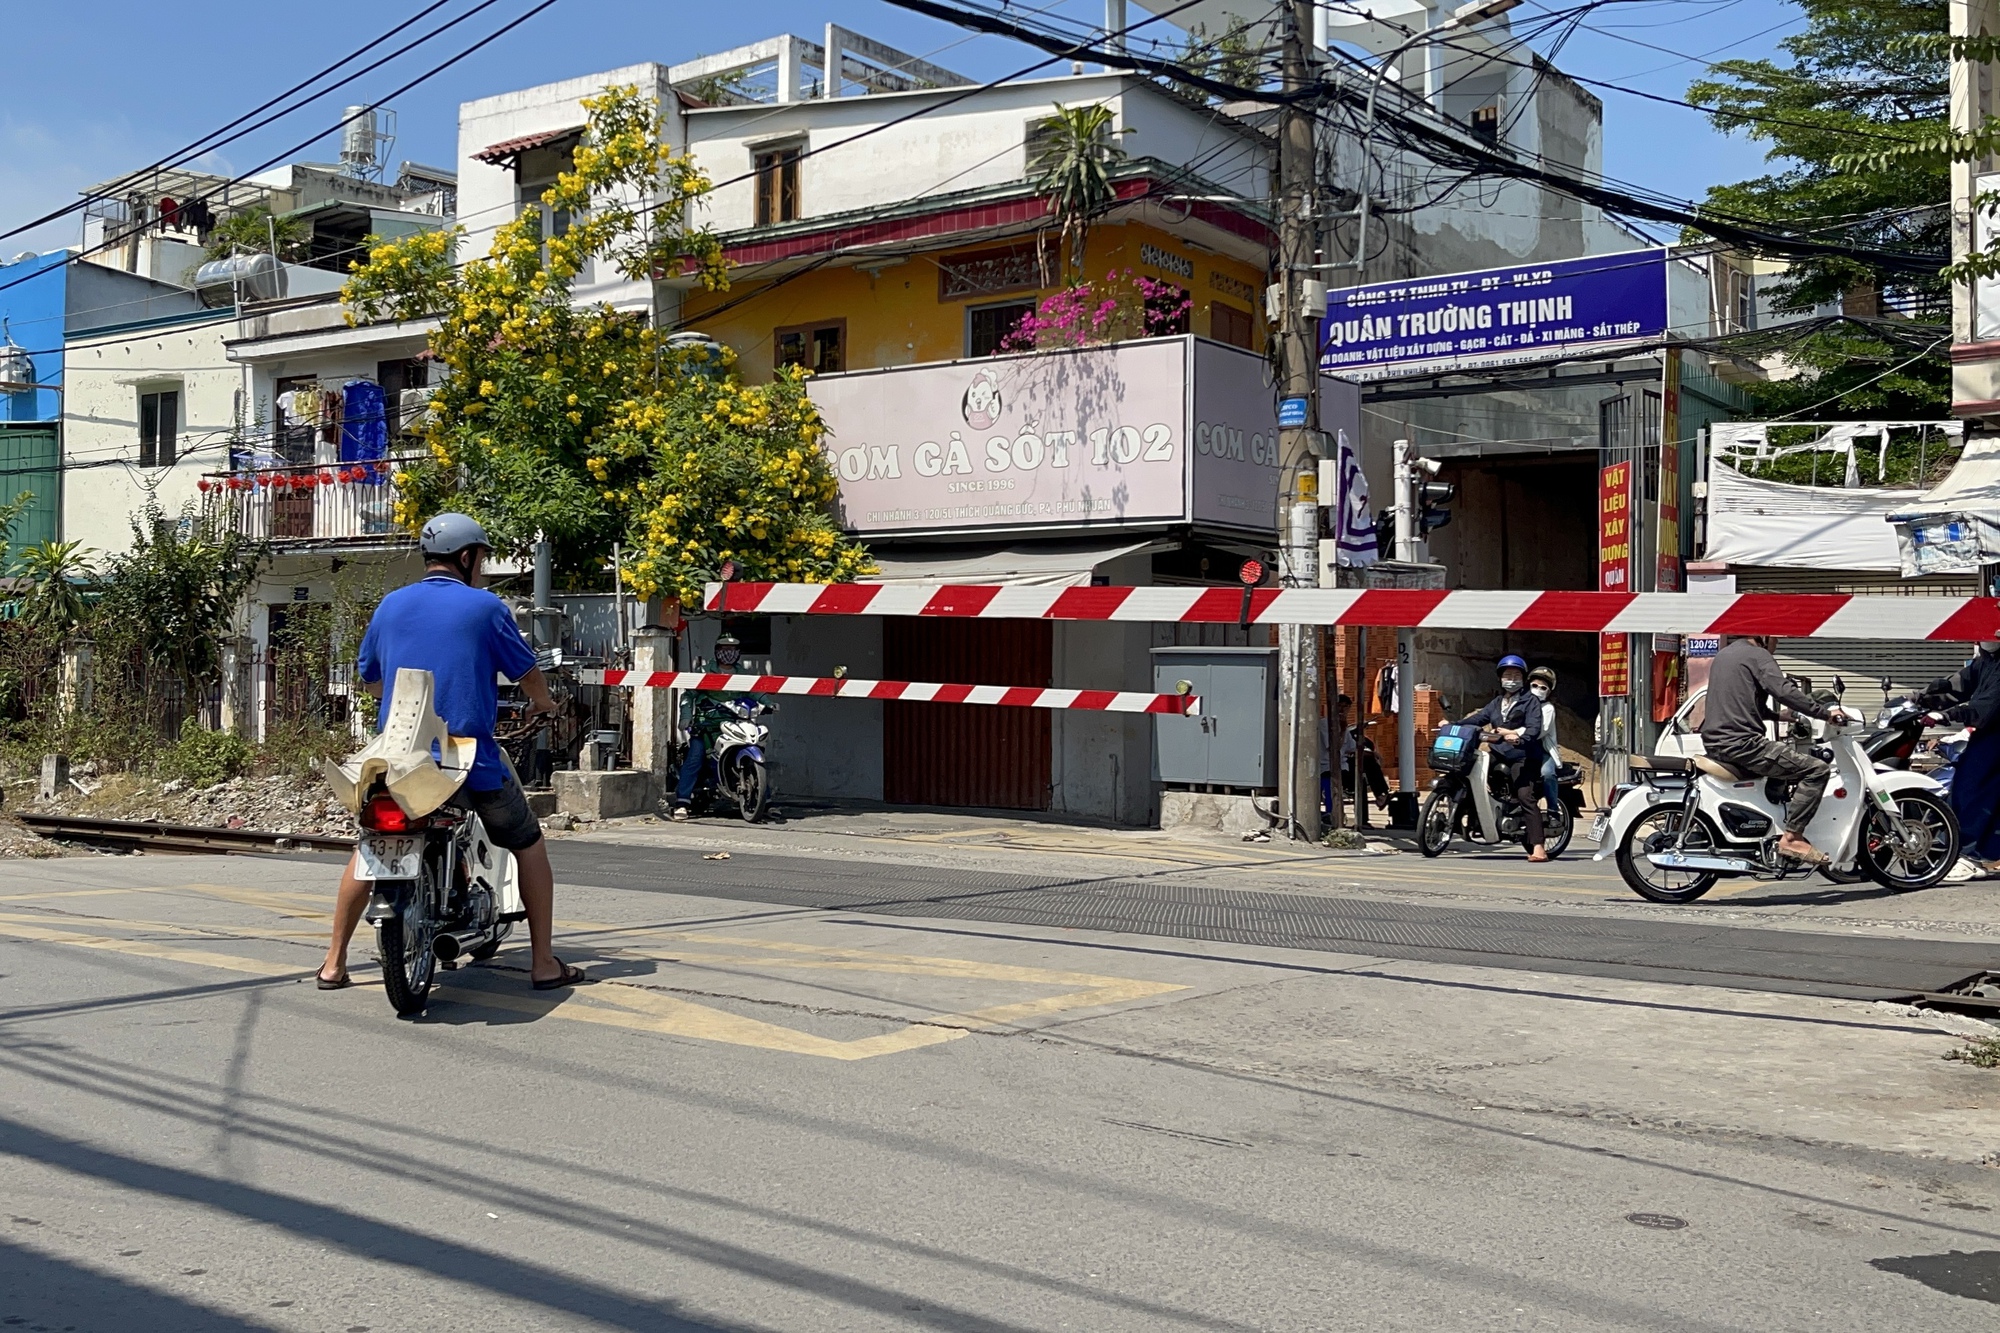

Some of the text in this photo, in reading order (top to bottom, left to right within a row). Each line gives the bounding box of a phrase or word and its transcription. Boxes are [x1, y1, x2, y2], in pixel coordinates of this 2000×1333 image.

[1346, 289, 1387, 308] CÔNG
[1513, 270, 1553, 288] VLXD
[1330, 295, 1572, 347] QUÂN TRƯỜNG THỊNH
[1331, 350, 1366, 364] DOANH:
[1366, 345, 1383, 362] VẬT
[1384, 343, 1406, 360] LIỆU
[1406, 341, 1426, 355] XÂY
[1426, 340, 1453, 355] DỰNG
[1460, 337, 1485, 351] GẠCH
[1493, 332, 1513, 347] CÁT
[1520, 329, 1534, 344] ĐÁ
[1542, 331, 1552, 342] XI
[1554, 326, 1585, 341] MĂNG
[1592, 321, 1613, 337] SẮT
[1614, 320, 1641, 335] THÉP
[913, 431, 974, 478] GÀ
[984, 419, 1077, 473] SỐT
[1089, 423, 1175, 467] 102
[1195, 420, 1246, 463] CƠM
[948, 478, 1016, 494] SINCE 1996
[1605, 467, 1625, 489] VẬT
[866, 511, 881, 524] CHI
[883, 507, 913, 523] NHÁNH
[954, 503, 981, 519] THÍCH
[1056, 499, 1076, 514] PHÚ
[1603, 492, 1626, 514] LIỆU
[1604, 517, 1625, 538] XÂY
[1601, 542, 1629, 565] DỰNG
[1605, 566, 1625, 587] QUÂN
[1690, 640, 1718, 650] 120/25
[1402, 652, 1410, 664] 2
